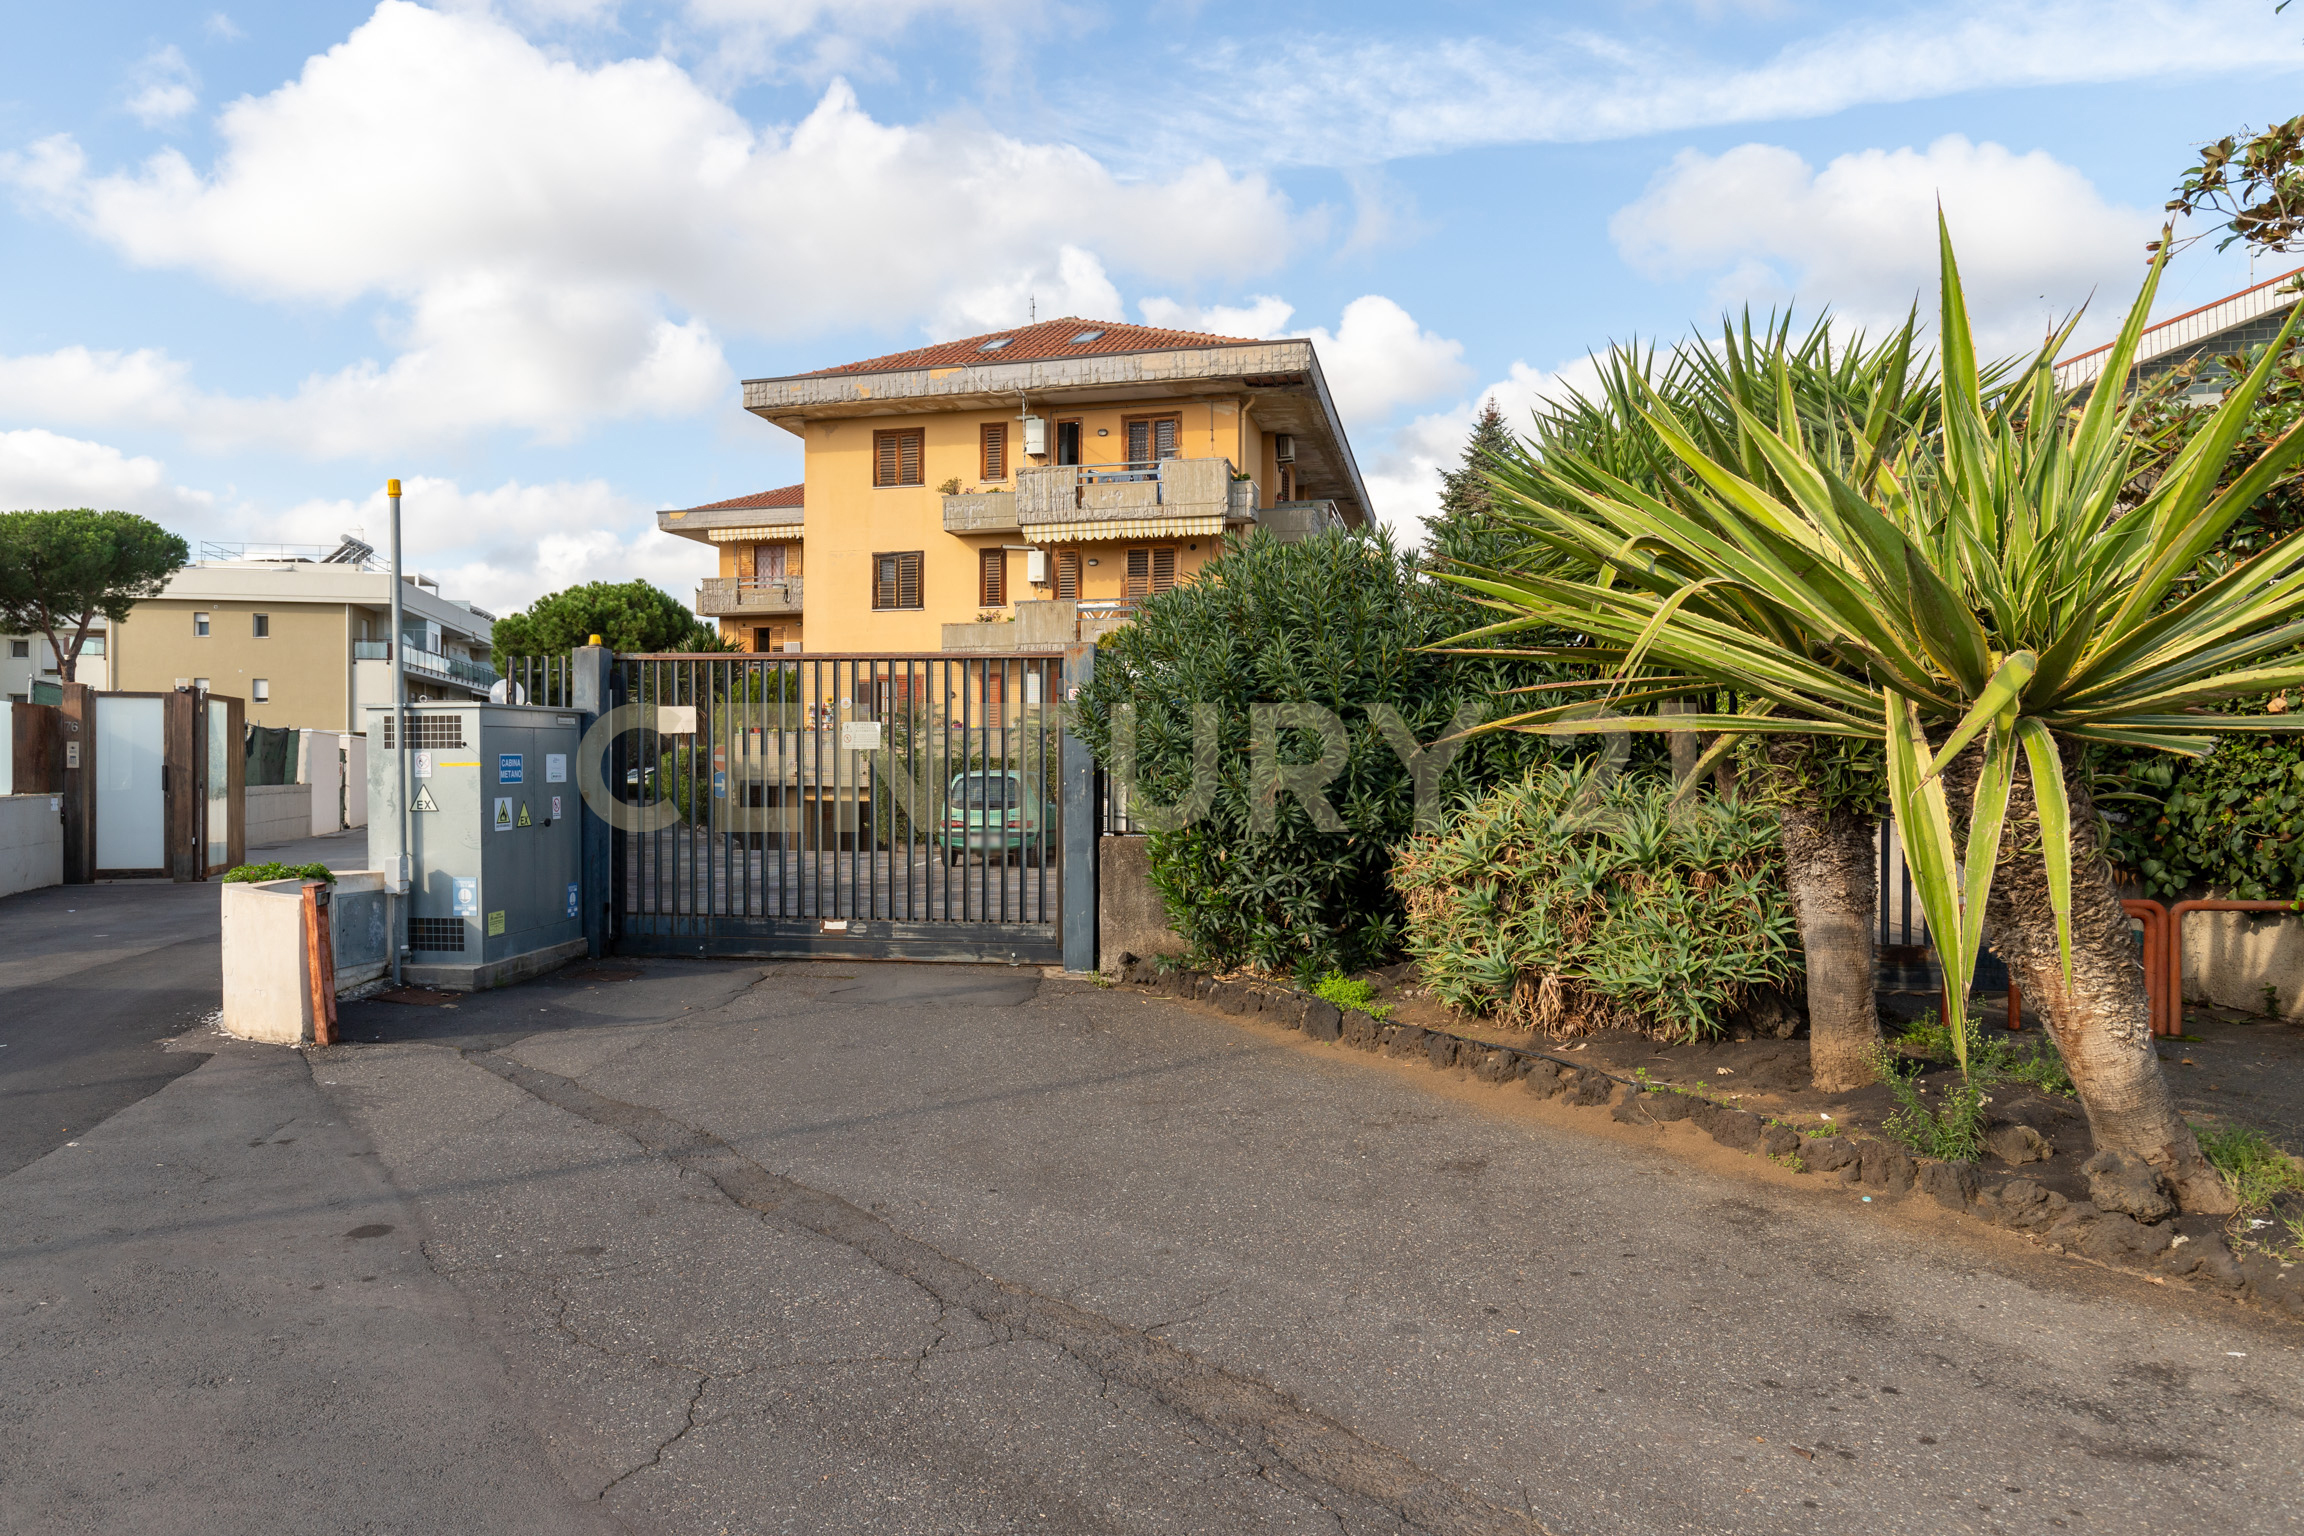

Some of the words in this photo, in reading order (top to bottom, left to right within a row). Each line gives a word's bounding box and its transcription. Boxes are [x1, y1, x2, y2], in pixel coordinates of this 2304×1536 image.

[64, 721, 79, 732] 76
[501, 758, 521, 767] CABINA
[500, 769, 522, 778] METANO
[416, 800, 431, 810] EX
[520, 816, 529, 825] EX
